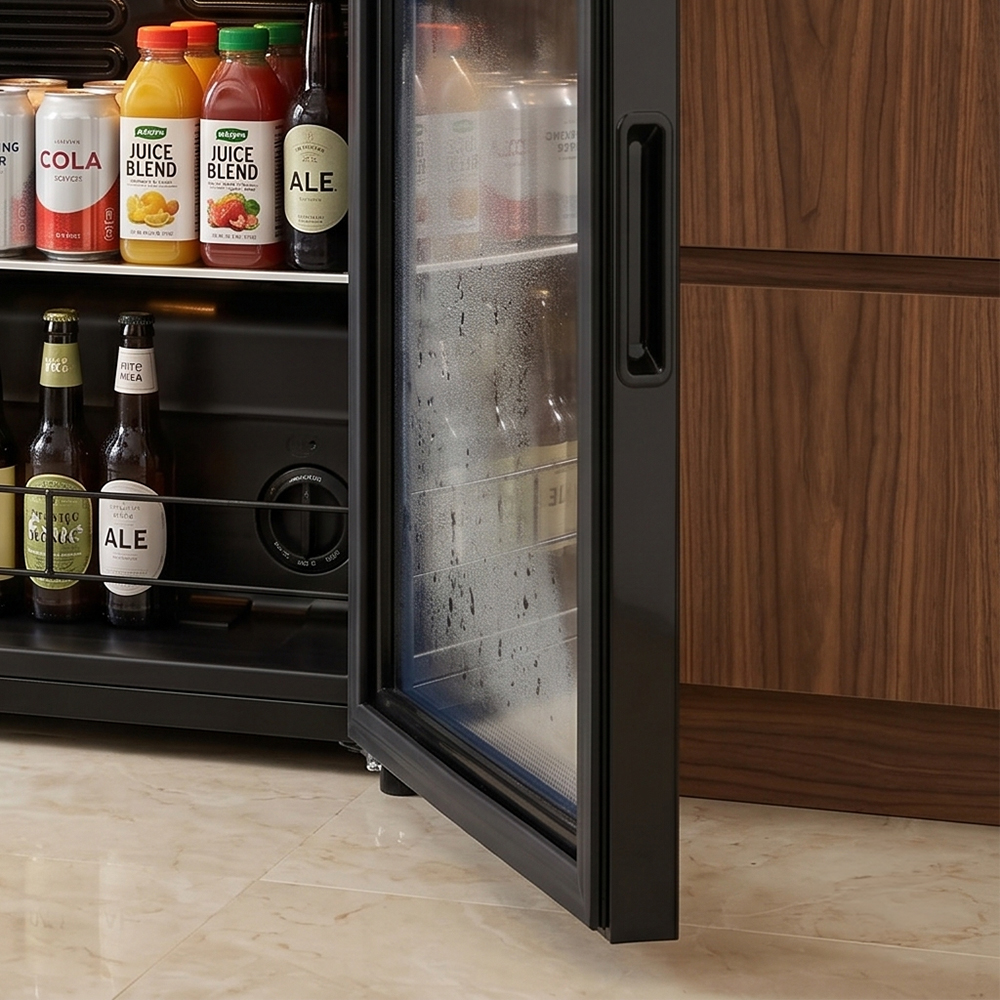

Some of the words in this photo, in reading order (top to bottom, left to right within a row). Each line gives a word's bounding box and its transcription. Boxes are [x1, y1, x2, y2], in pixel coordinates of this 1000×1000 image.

[40, 150, 102, 170] COLA
[129, 143, 173, 160] JUICE
[211, 145, 254, 163] JUICE
[126, 160, 177, 178] BLEND
[207, 162, 258, 180] BLEND
[104, 527, 148, 550] ALE
